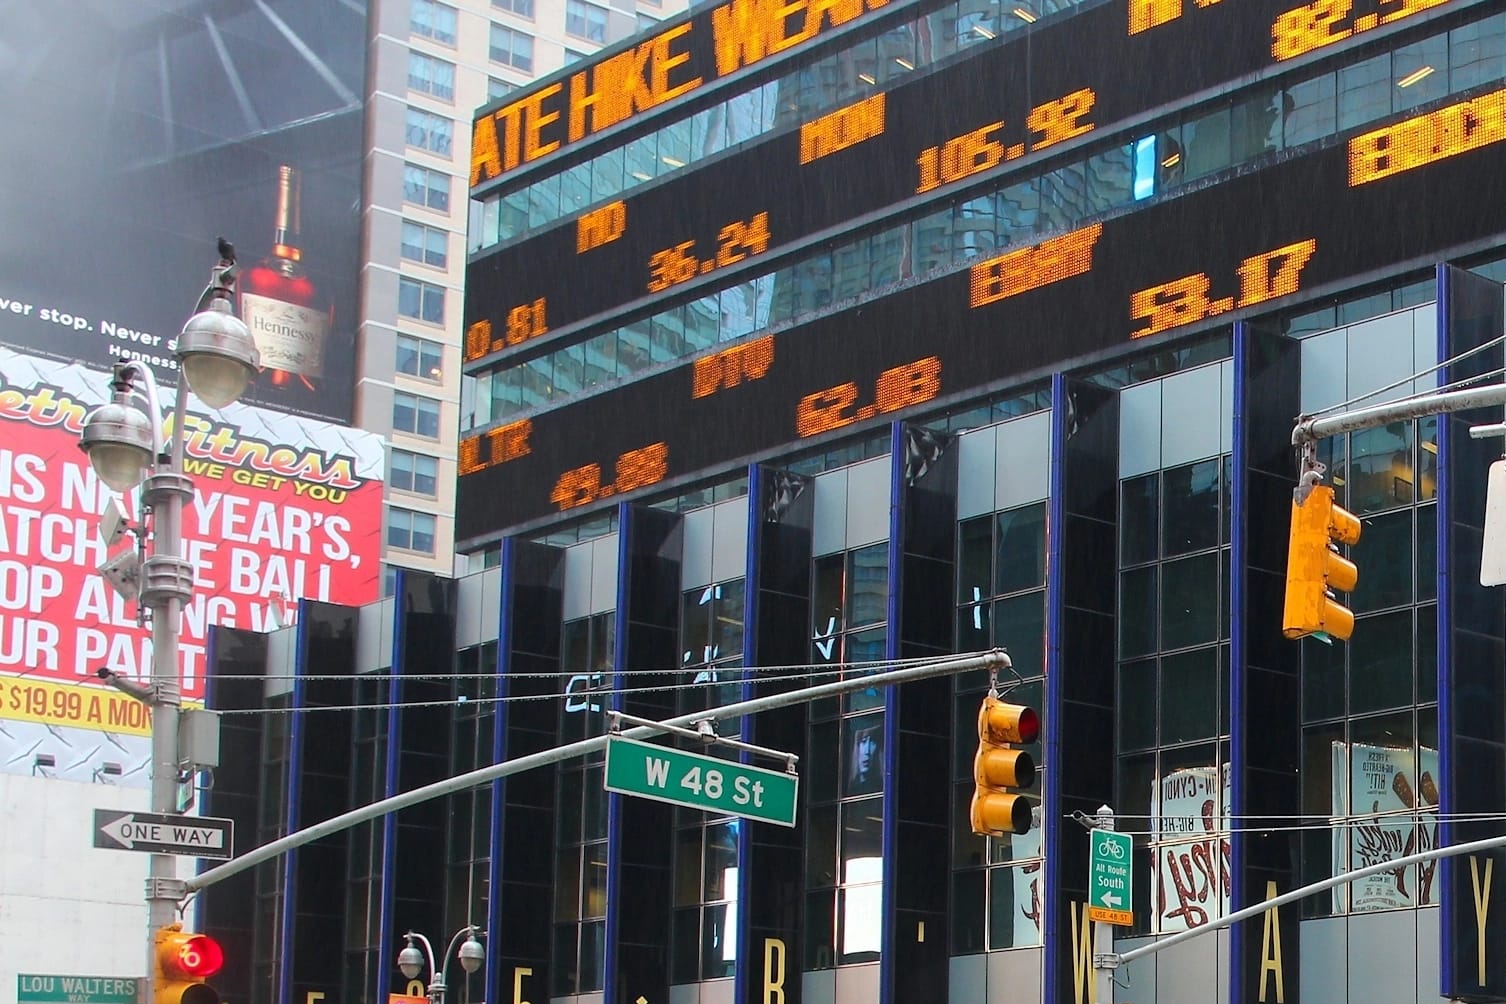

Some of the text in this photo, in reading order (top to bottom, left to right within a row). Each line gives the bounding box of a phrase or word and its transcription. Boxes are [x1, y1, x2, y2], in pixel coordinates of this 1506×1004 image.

[568, 22, 703, 144] HIKE
[647, 210, 772, 294] 36.24
[1129, 238, 1316, 340] 53.17
[39, 307, 93, 332] stop.
[100, 320, 162, 347] Never
[464, 297, 549, 364] 0.81
[183, 458, 349, 505] WE GET YOU
[192, 493, 362, 570] YEAR'S,
[75, 573, 237, 640] ALNG
[75, 626, 208, 690] PAT
[10, 684, 153, 731] $19.99 A MON
[644, 755, 765, 808] W 48 St
[120, 823, 214, 846] ONE WAY
[1095, 863, 1127, 877] Alt Route
[1097, 875, 1124, 889] South
[1094, 911, 1106, 919] USE
[21, 976, 136, 996] LOU WALTERS
[68, 994, 91, 1004] WAY
